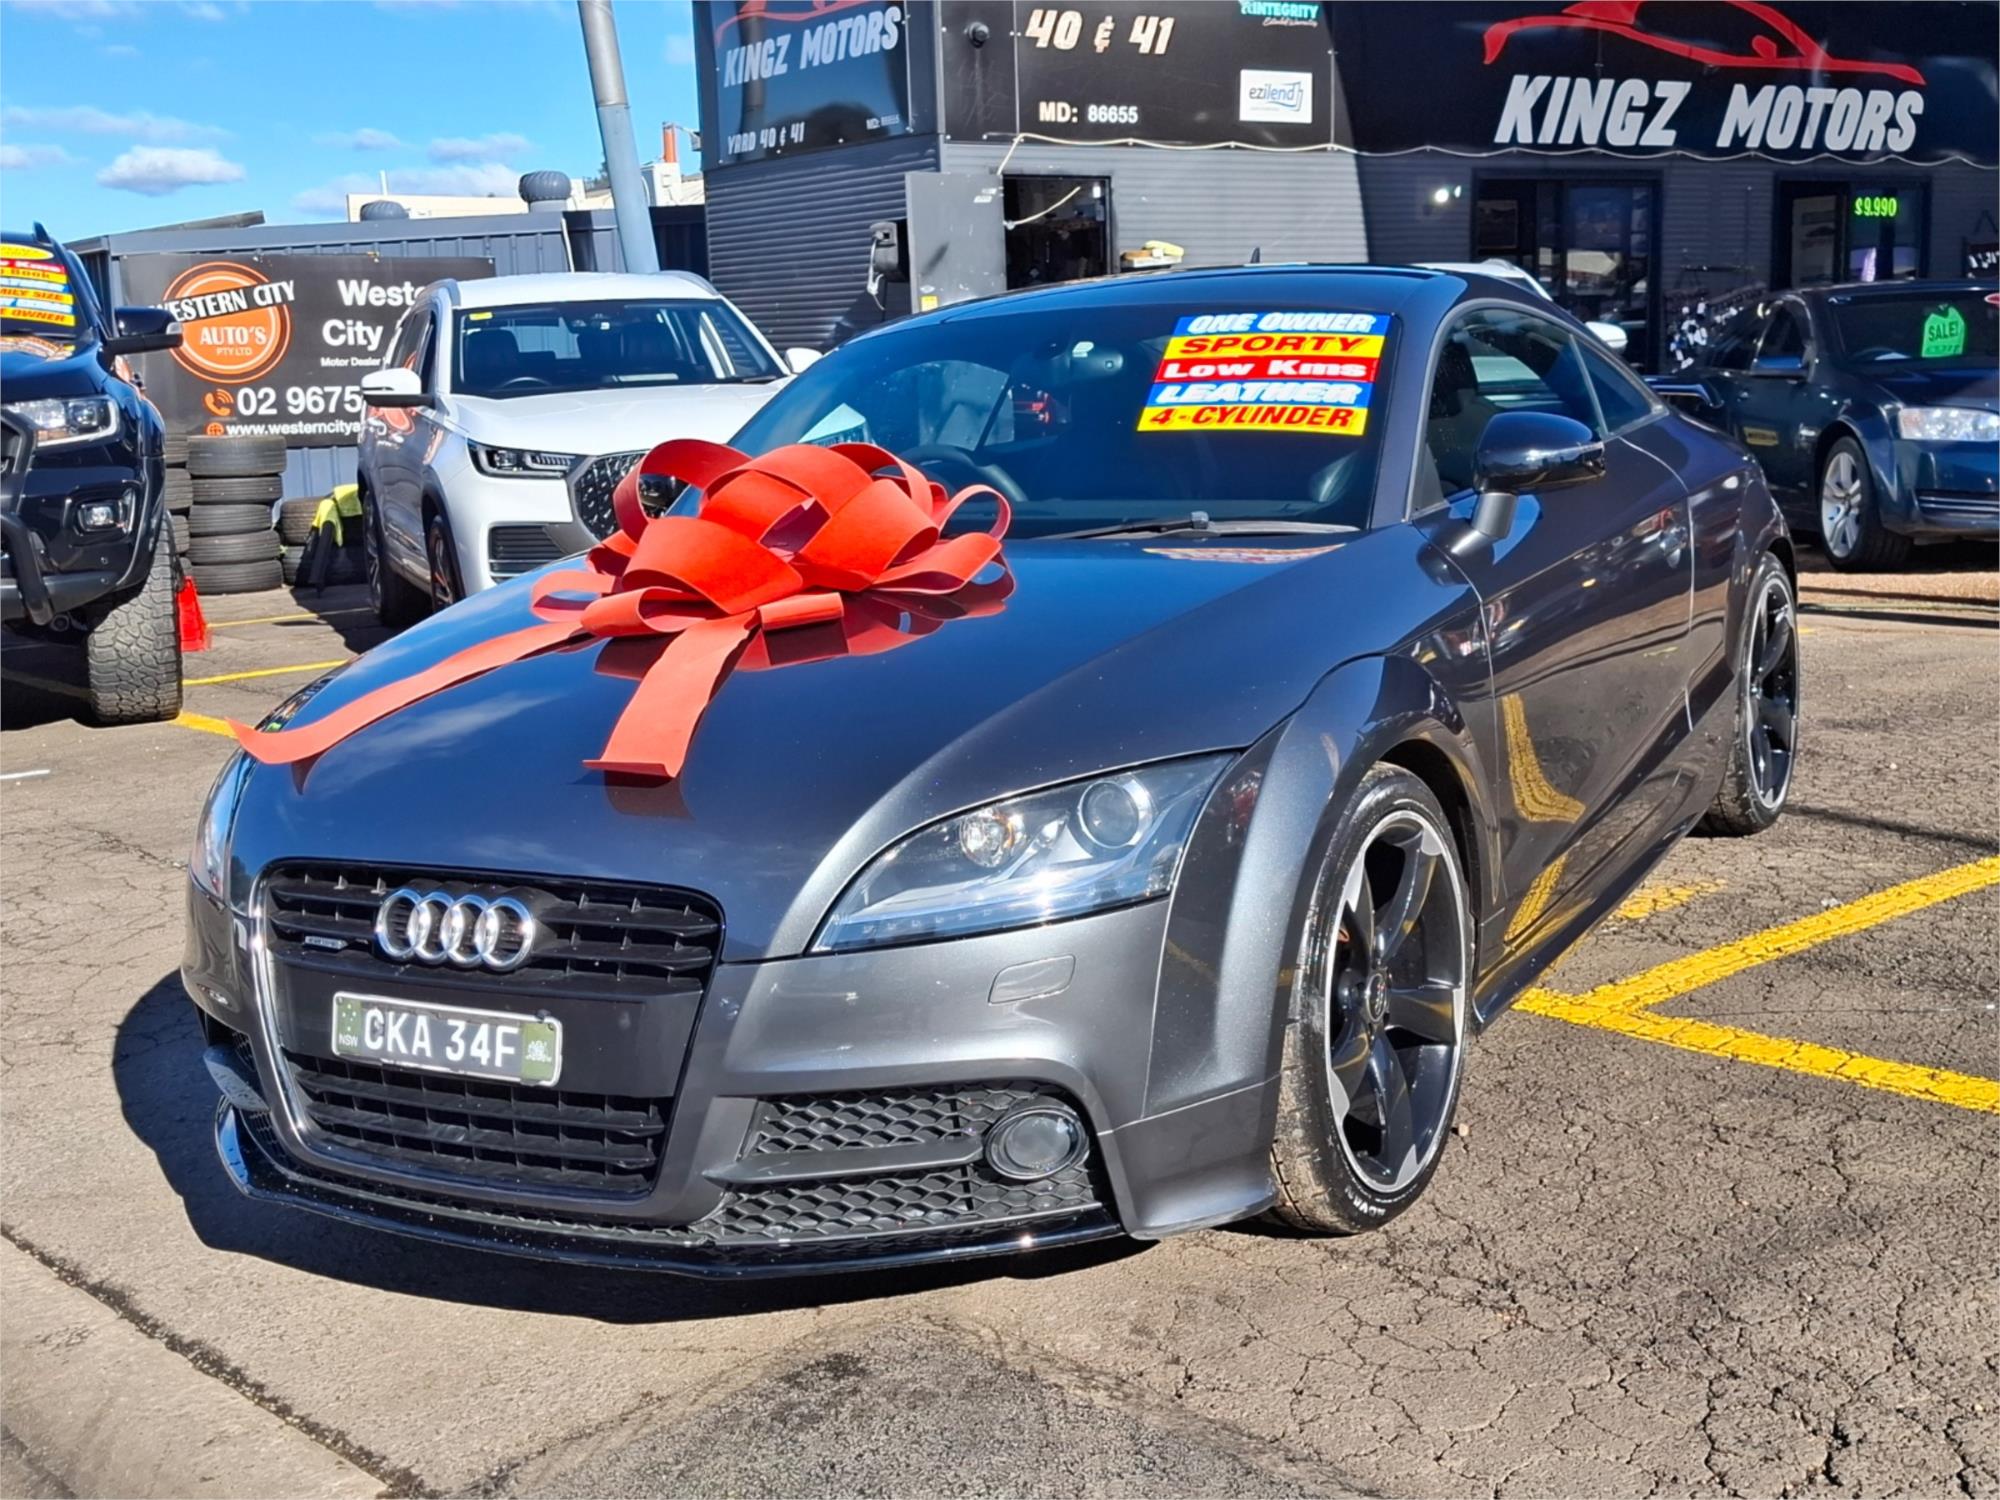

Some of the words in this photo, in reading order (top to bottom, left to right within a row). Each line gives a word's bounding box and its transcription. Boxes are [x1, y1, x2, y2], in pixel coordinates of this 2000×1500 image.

[1025, 9, 1083, 50] 40
[1128, 15, 1175, 55] 41
[724, 34, 791, 88] KINGZ
[799, 6, 902, 70] MOTORS
[1248, 83, 1296, 100] ezilend
[1039, 101, 1079, 123] MD:
[1087, 104, 1139, 124] 86655
[1494, 75, 1691, 147] KINGZ
[1716, 84, 1924, 152] MOTORS
[727, 130, 757, 156] YARD
[760, 127, 777, 149] 40
[790, 121, 806, 144] 41
[253, 280, 295, 307] CITY
[12, 308, 65, 323] OWNER
[1187, 314, 1257, 334] ONE
[1257, 312, 1377, 333] OWNER
[200, 326, 267, 345] AUTO'S
[322, 318, 384, 351] City
[1180, 336, 1369, 354] SPORTY
[321, 357, 349, 366] Motor
[351, 357, 380, 366] Dealer
[1164, 363, 1255, 378] Low
[1267, 360, 1367, 377] Kms
[237, 387, 277, 416] 02
[285, 385, 362, 414] 9675
[1155, 382, 1362, 404] LEATHER
[338, 1034, 359, 1047] NSW
[364, 1009, 432, 1058] CKA
[445, 1018, 519, 1067] 34F
